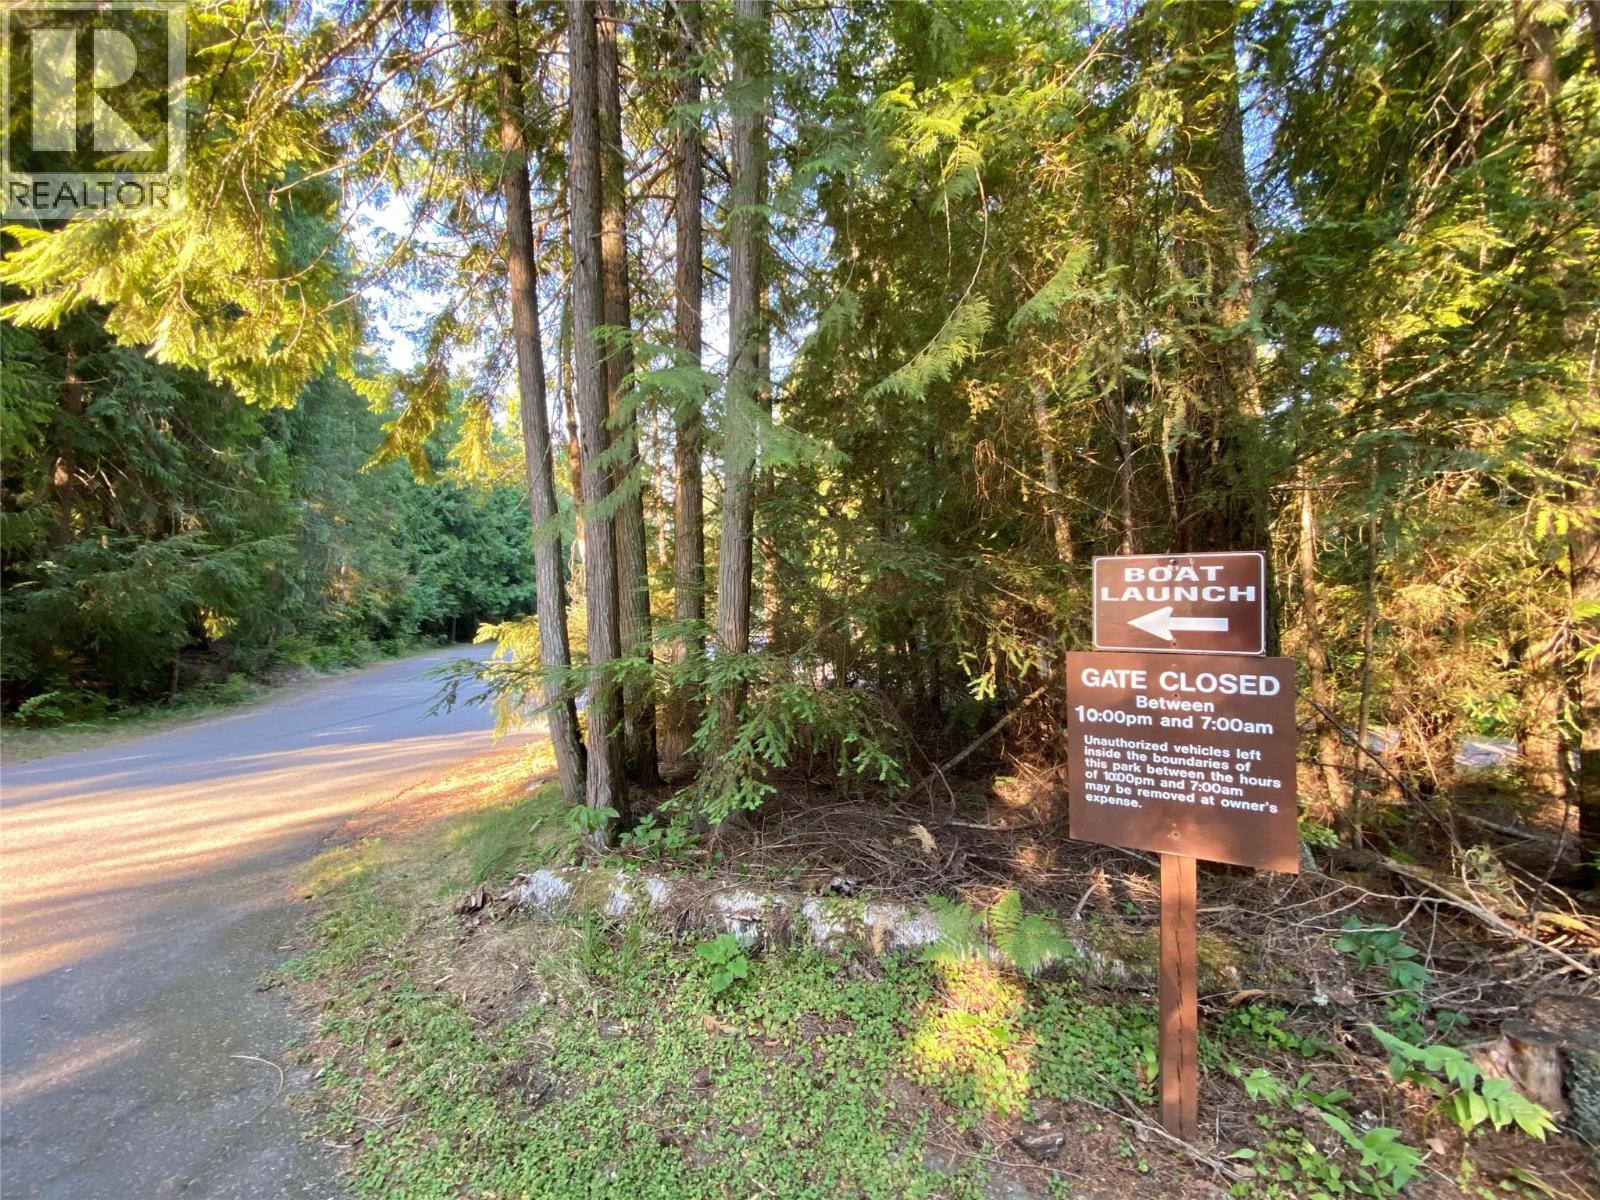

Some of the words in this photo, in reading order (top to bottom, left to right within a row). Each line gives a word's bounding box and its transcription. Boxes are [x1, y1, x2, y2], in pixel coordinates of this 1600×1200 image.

[1124, 566, 1224, 582] BOAT
[1100, 586, 1256, 602] LAUNCH
[1081, 667, 1147, 689] GATE
[1159, 671, 1281, 696] CLOSED
[1136, 696, 1215, 713] Between
[1075, 705, 1152, 726] 10:00pm
[1160, 715, 1193, 728] and
[1201, 716, 1273, 735] 7:00am
[1084, 735, 1168, 752] Unauthorized
[1174, 742, 1230, 758] vehicles
[1236, 748, 1262, 761] left
[1084, 746, 1121, 759] inside
[1127, 750, 1148, 761] the
[1153, 752, 1229, 770] boundaries
[1236, 761, 1251, 772] of
[1085, 758, 1108, 769] this
[1113, 761, 1141, 776] park
[1146, 764, 1205, 780] between
[1210, 771, 1233, 783] the
[1240, 774, 1282, 789] hours
[1085, 769, 1099, 780] of
[1160, 778, 1185, 790] and
[1190, 781, 1243, 797] 7:00am
[1085, 782, 1110, 794] may
[1116, 784, 1132, 795] be
[1137, 788, 1195, 804] removed
[1200, 795, 1215, 806] at
[1220, 799, 1278, 814] owner's
[1085, 793, 1142, 808] expense.
